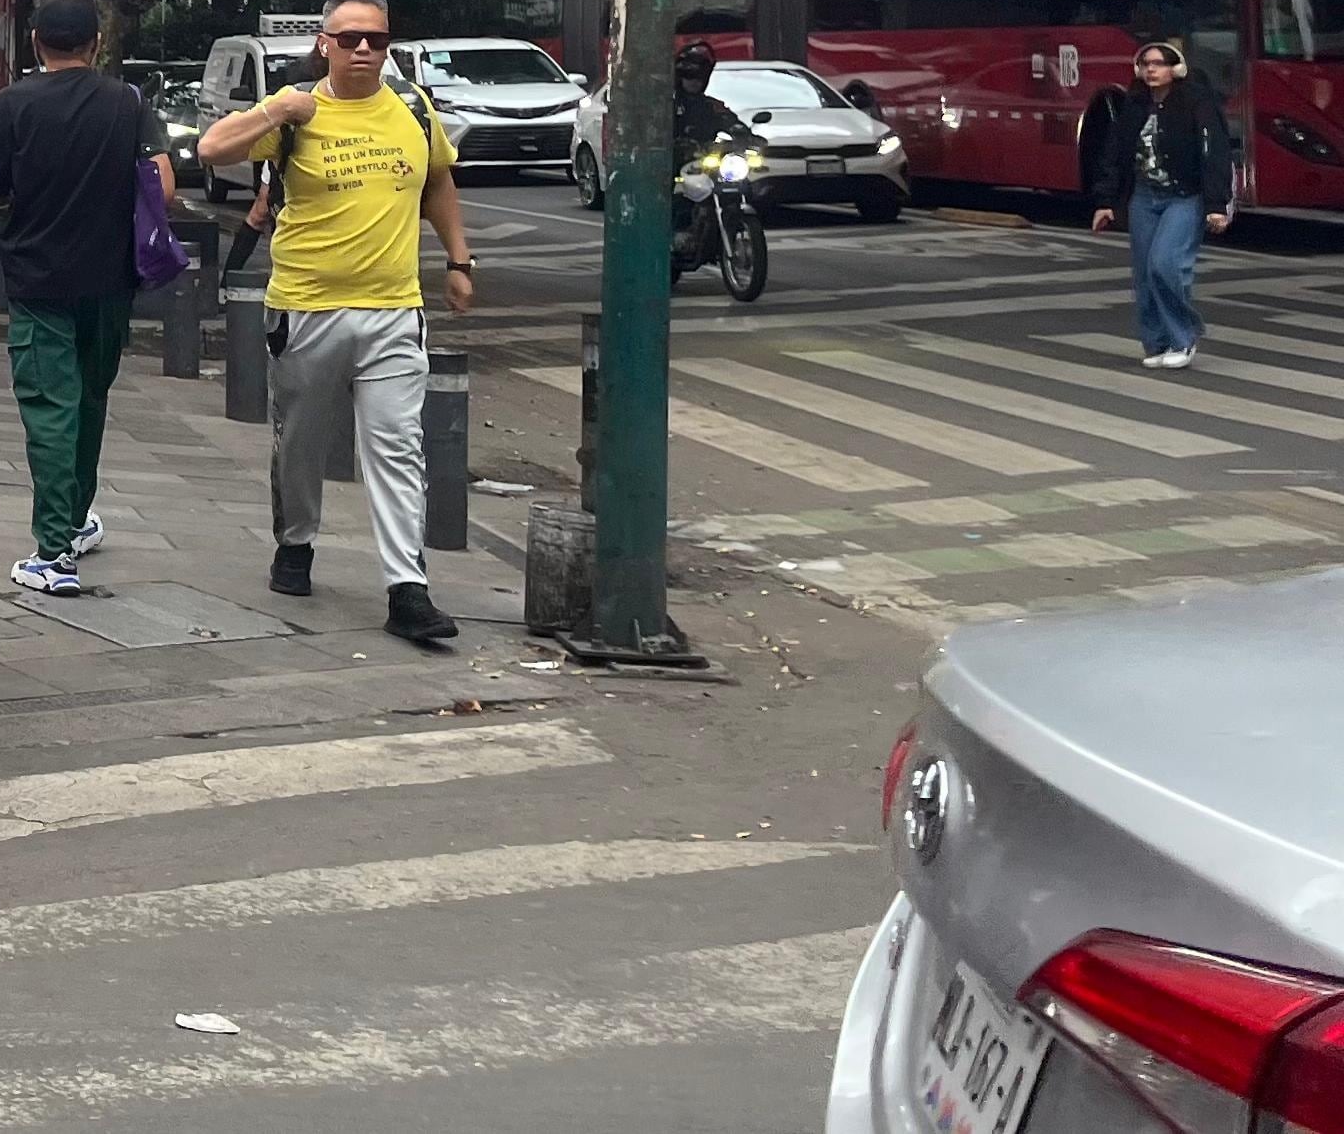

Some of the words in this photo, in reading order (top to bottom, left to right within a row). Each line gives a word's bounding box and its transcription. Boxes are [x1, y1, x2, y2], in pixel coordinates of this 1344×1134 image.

[321, 140, 332, 150] EL
[323, 155, 337, 164] NO
[339, 153, 351, 162] ES
[353, 150, 366, 159] UN
[369, 147, 403, 157] EQUIPO
[325, 169, 338, 178] ES
[340, 166, 353, 176] UN
[356, 162, 388, 174] ESTILO
[327, 183, 340, 192] DE
[342, 179, 364, 190] VIDA
